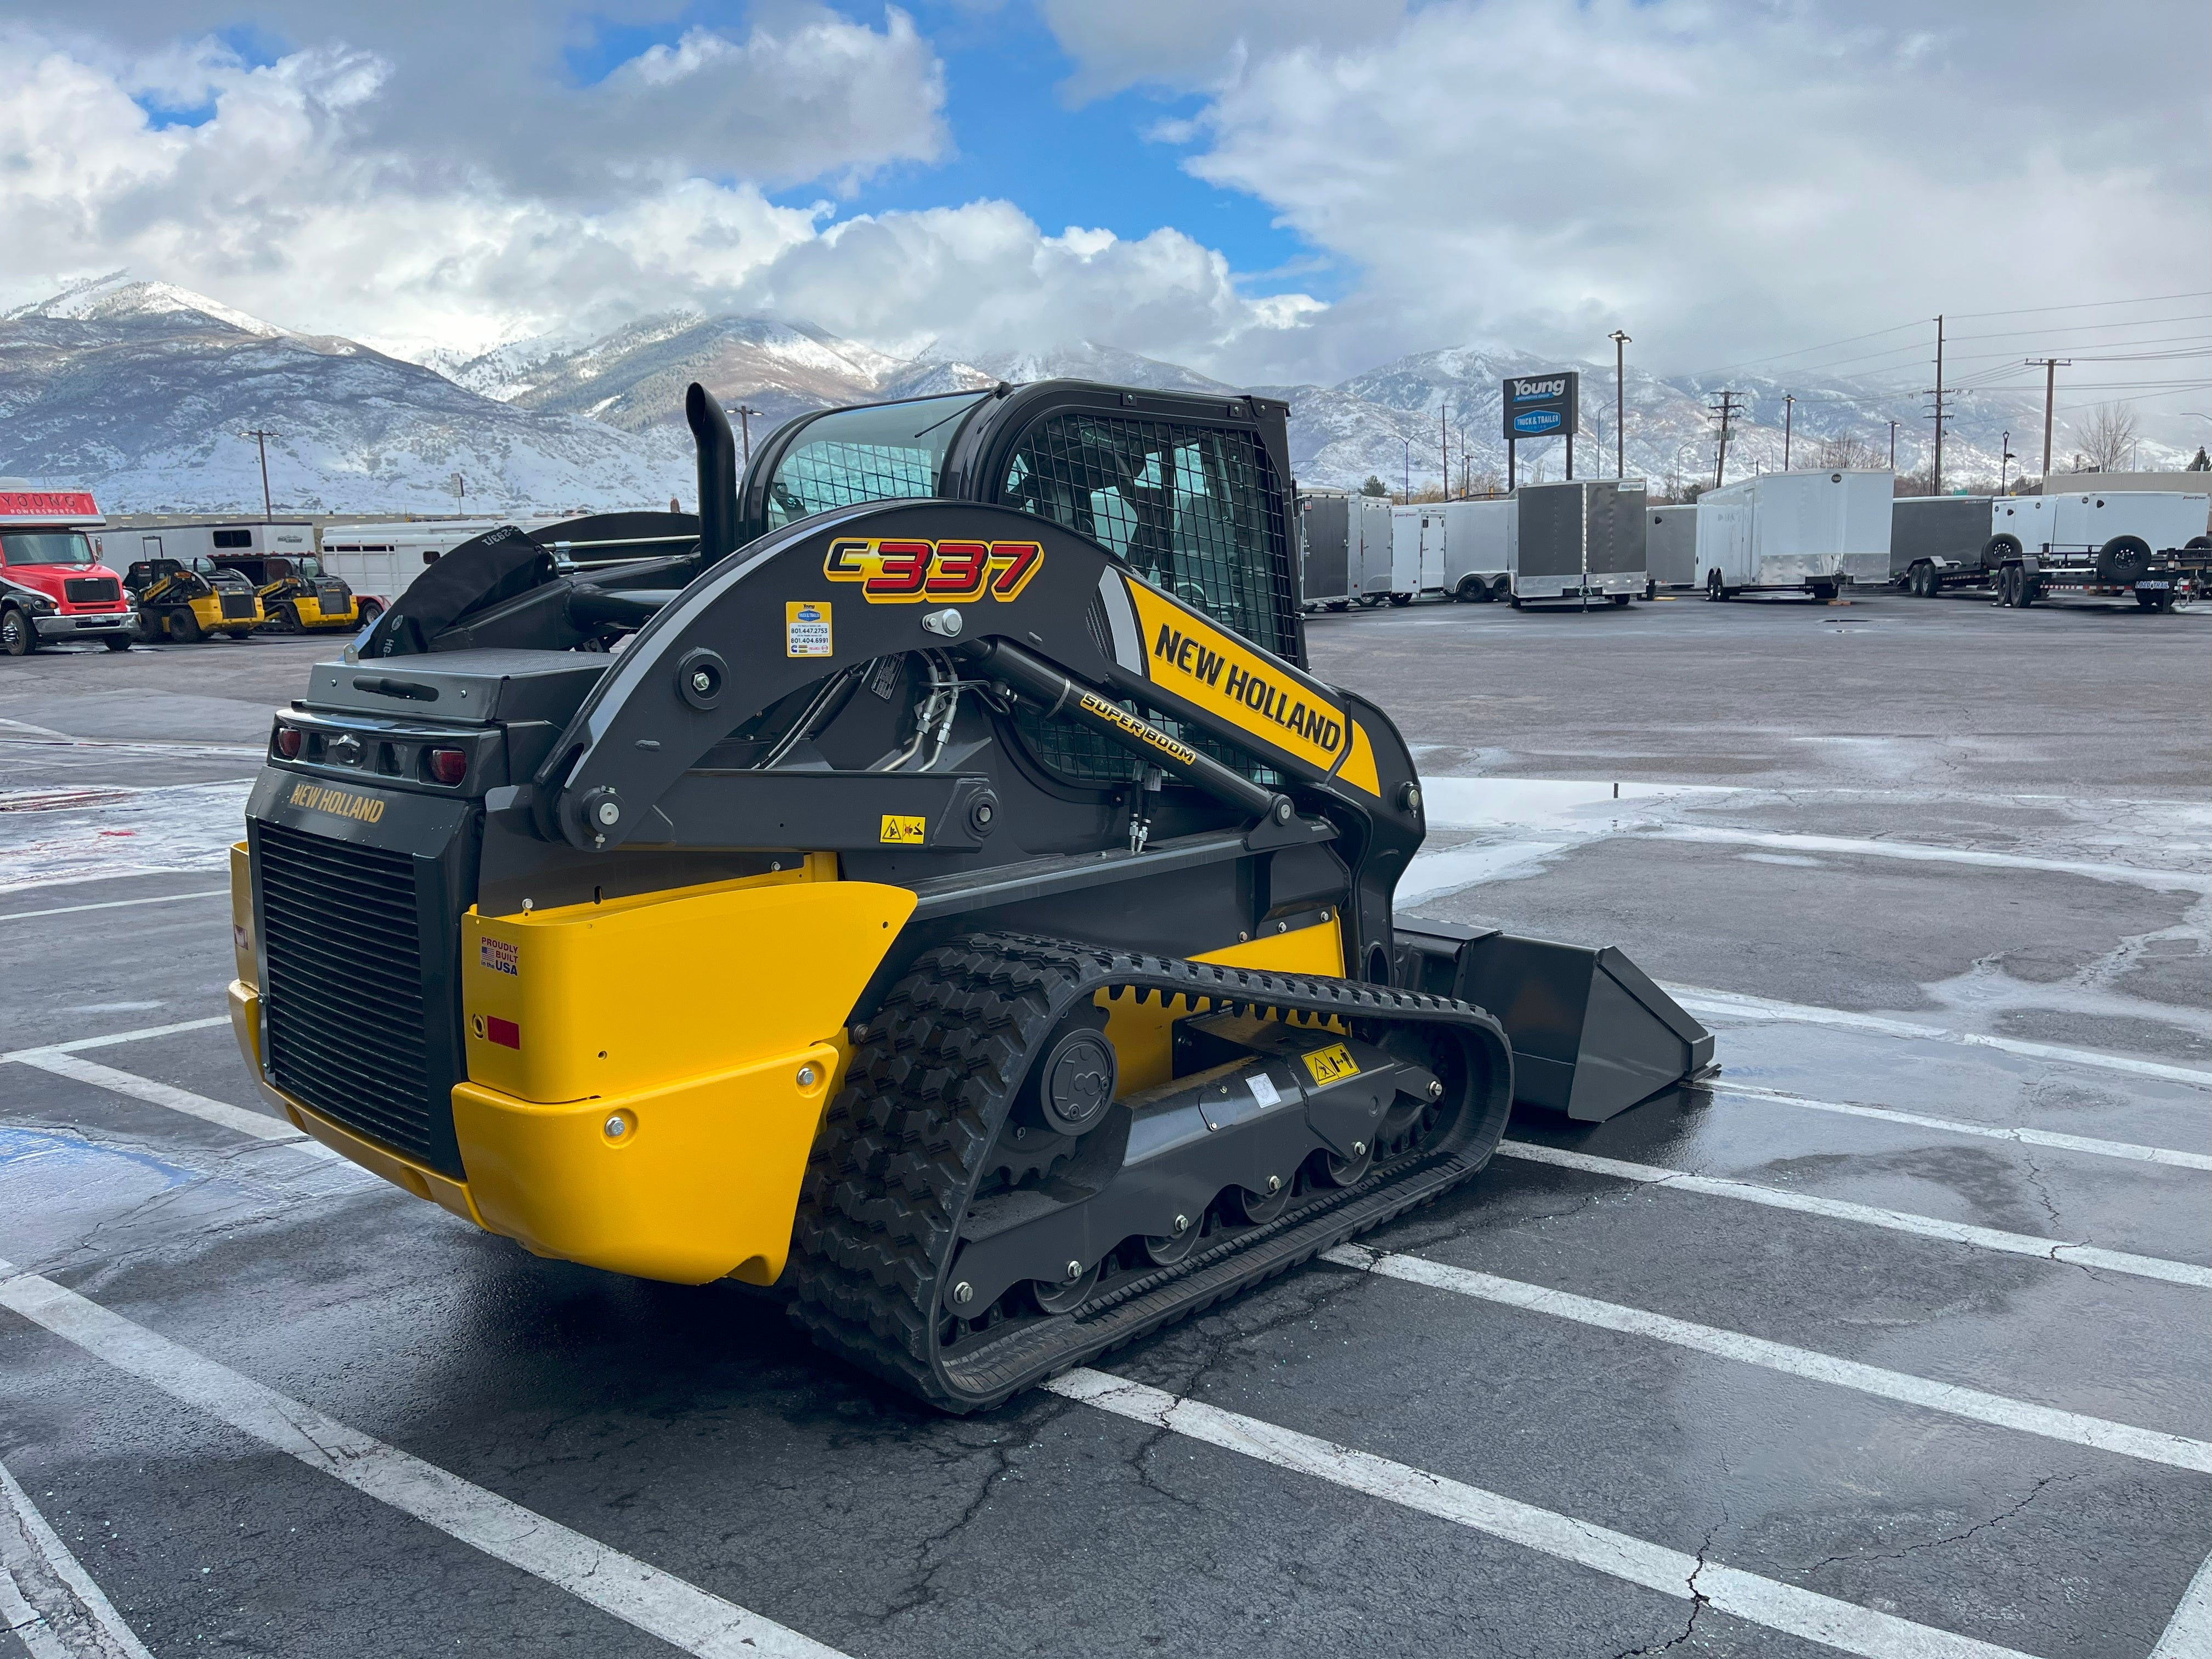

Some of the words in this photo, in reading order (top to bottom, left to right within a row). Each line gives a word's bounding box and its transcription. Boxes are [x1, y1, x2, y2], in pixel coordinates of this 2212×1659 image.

[1513, 379, 1566, 396] Young
[1517, 417, 1532, 425] TRUCK
[1533, 416, 1537, 425] &
[1538, 415, 1559, 424] TRAILER
[2, 495, 75, 507] YOUNG
[825, 538, 1042, 599] C337
[2153, 581, 2169, 589] TRAIL
[1154, 623, 1226, 687] NEW
[1224, 663, 1341, 753] HOLLAND
[1081, 693, 1144, 736] SUPER
[1143, 729, 1195, 764] BOOM
[290, 783, 323, 809] NEW
[318, 789, 385, 823] HOLLAND
[482, 936, 518, 954] PROUDLY
[495, 950, 518, 963] BUILT
[495, 960, 518, 976] USA
